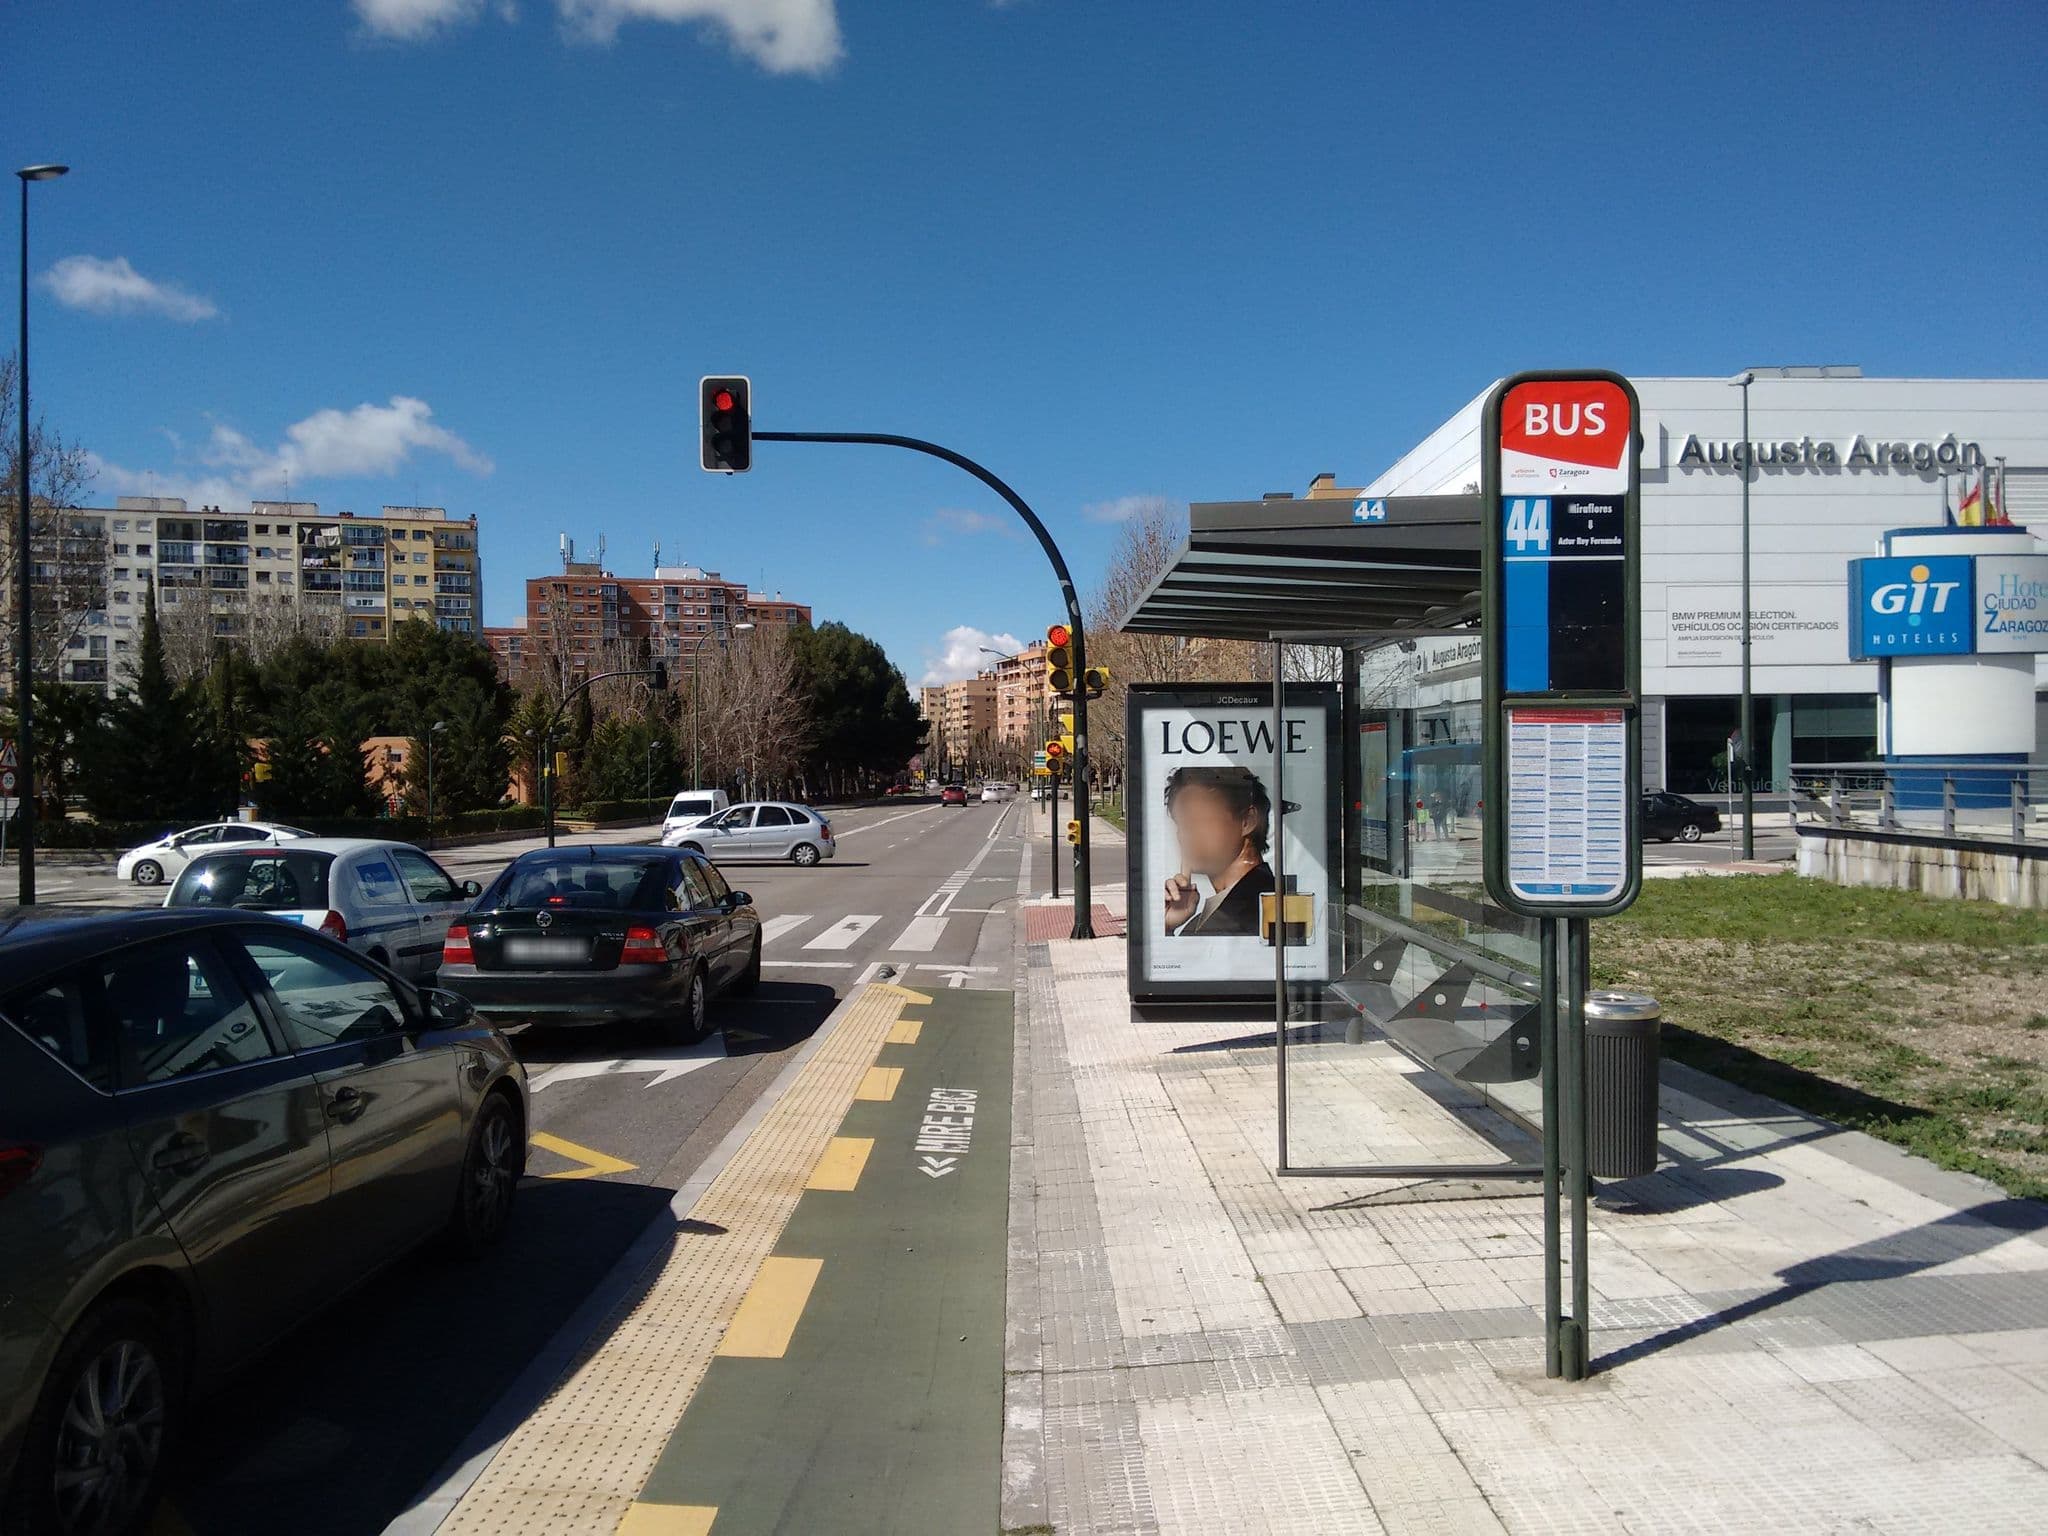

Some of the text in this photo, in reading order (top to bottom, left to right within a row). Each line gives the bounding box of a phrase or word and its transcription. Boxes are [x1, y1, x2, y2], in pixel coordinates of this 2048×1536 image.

[1525, 402, 1606, 436] BUS
[1679, 432, 1984, 471] Augusta Aragón
[1558, 468, 1590, 477] Zaragoza
[1354, 500, 1386, 520] 44
[1567, 502, 1613, 514] Miraflores
[1506, 499, 1549, 551] 44
[1671, 610, 1798, 621] BMW PREMIUM ELECTION.
[1727, 621, 1770, 631] OCSIÓN
[1771, 620, 1840, 631] CERTIFICADOS
[1872, 632, 1959, 645] HOTELES
[1216, 696, 1259, 705] JCDecaux
[1161, 720, 1307, 755] LOEWE
[914, 1087, 978, 1154] MIRE BICI
